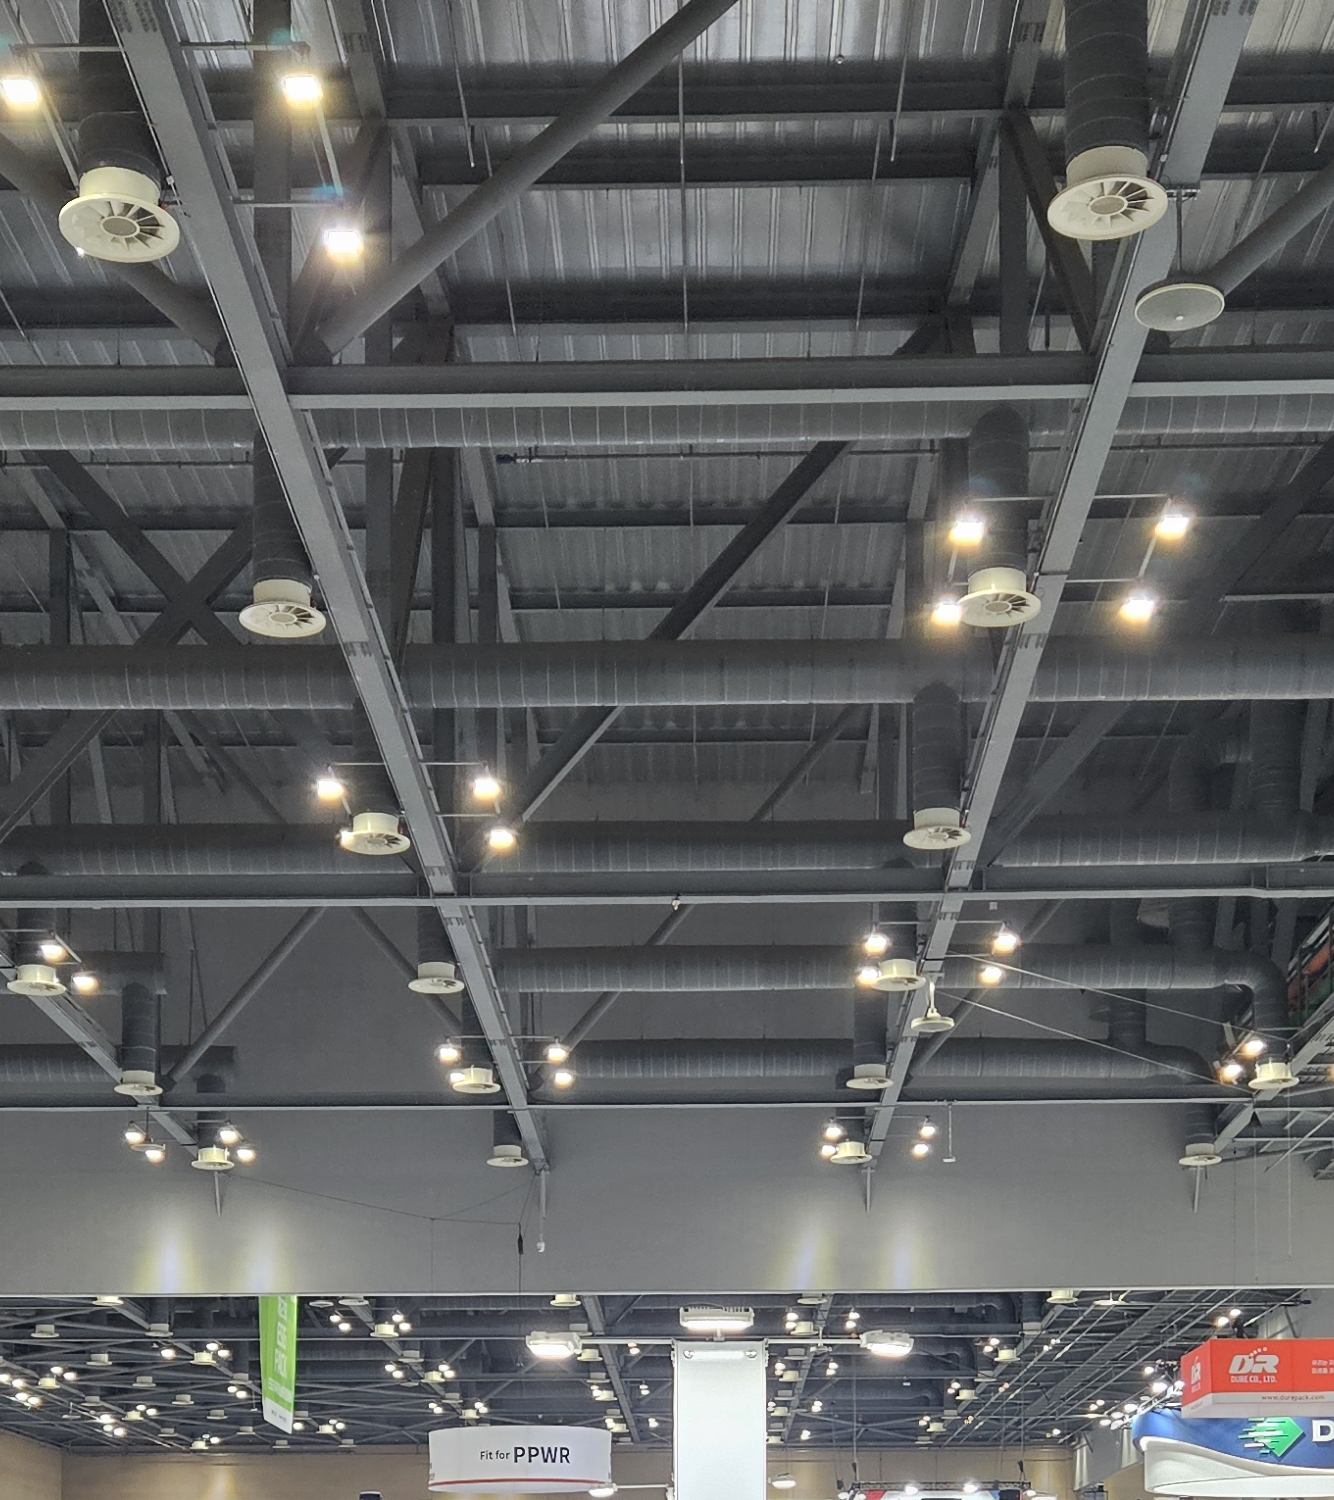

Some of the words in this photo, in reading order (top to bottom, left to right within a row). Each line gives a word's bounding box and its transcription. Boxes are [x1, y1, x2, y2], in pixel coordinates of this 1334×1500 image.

[480, 1451, 493, 1460] Fit
[495, 1450, 510, 1460] for
[513, 1446, 571, 1464] PPWR
